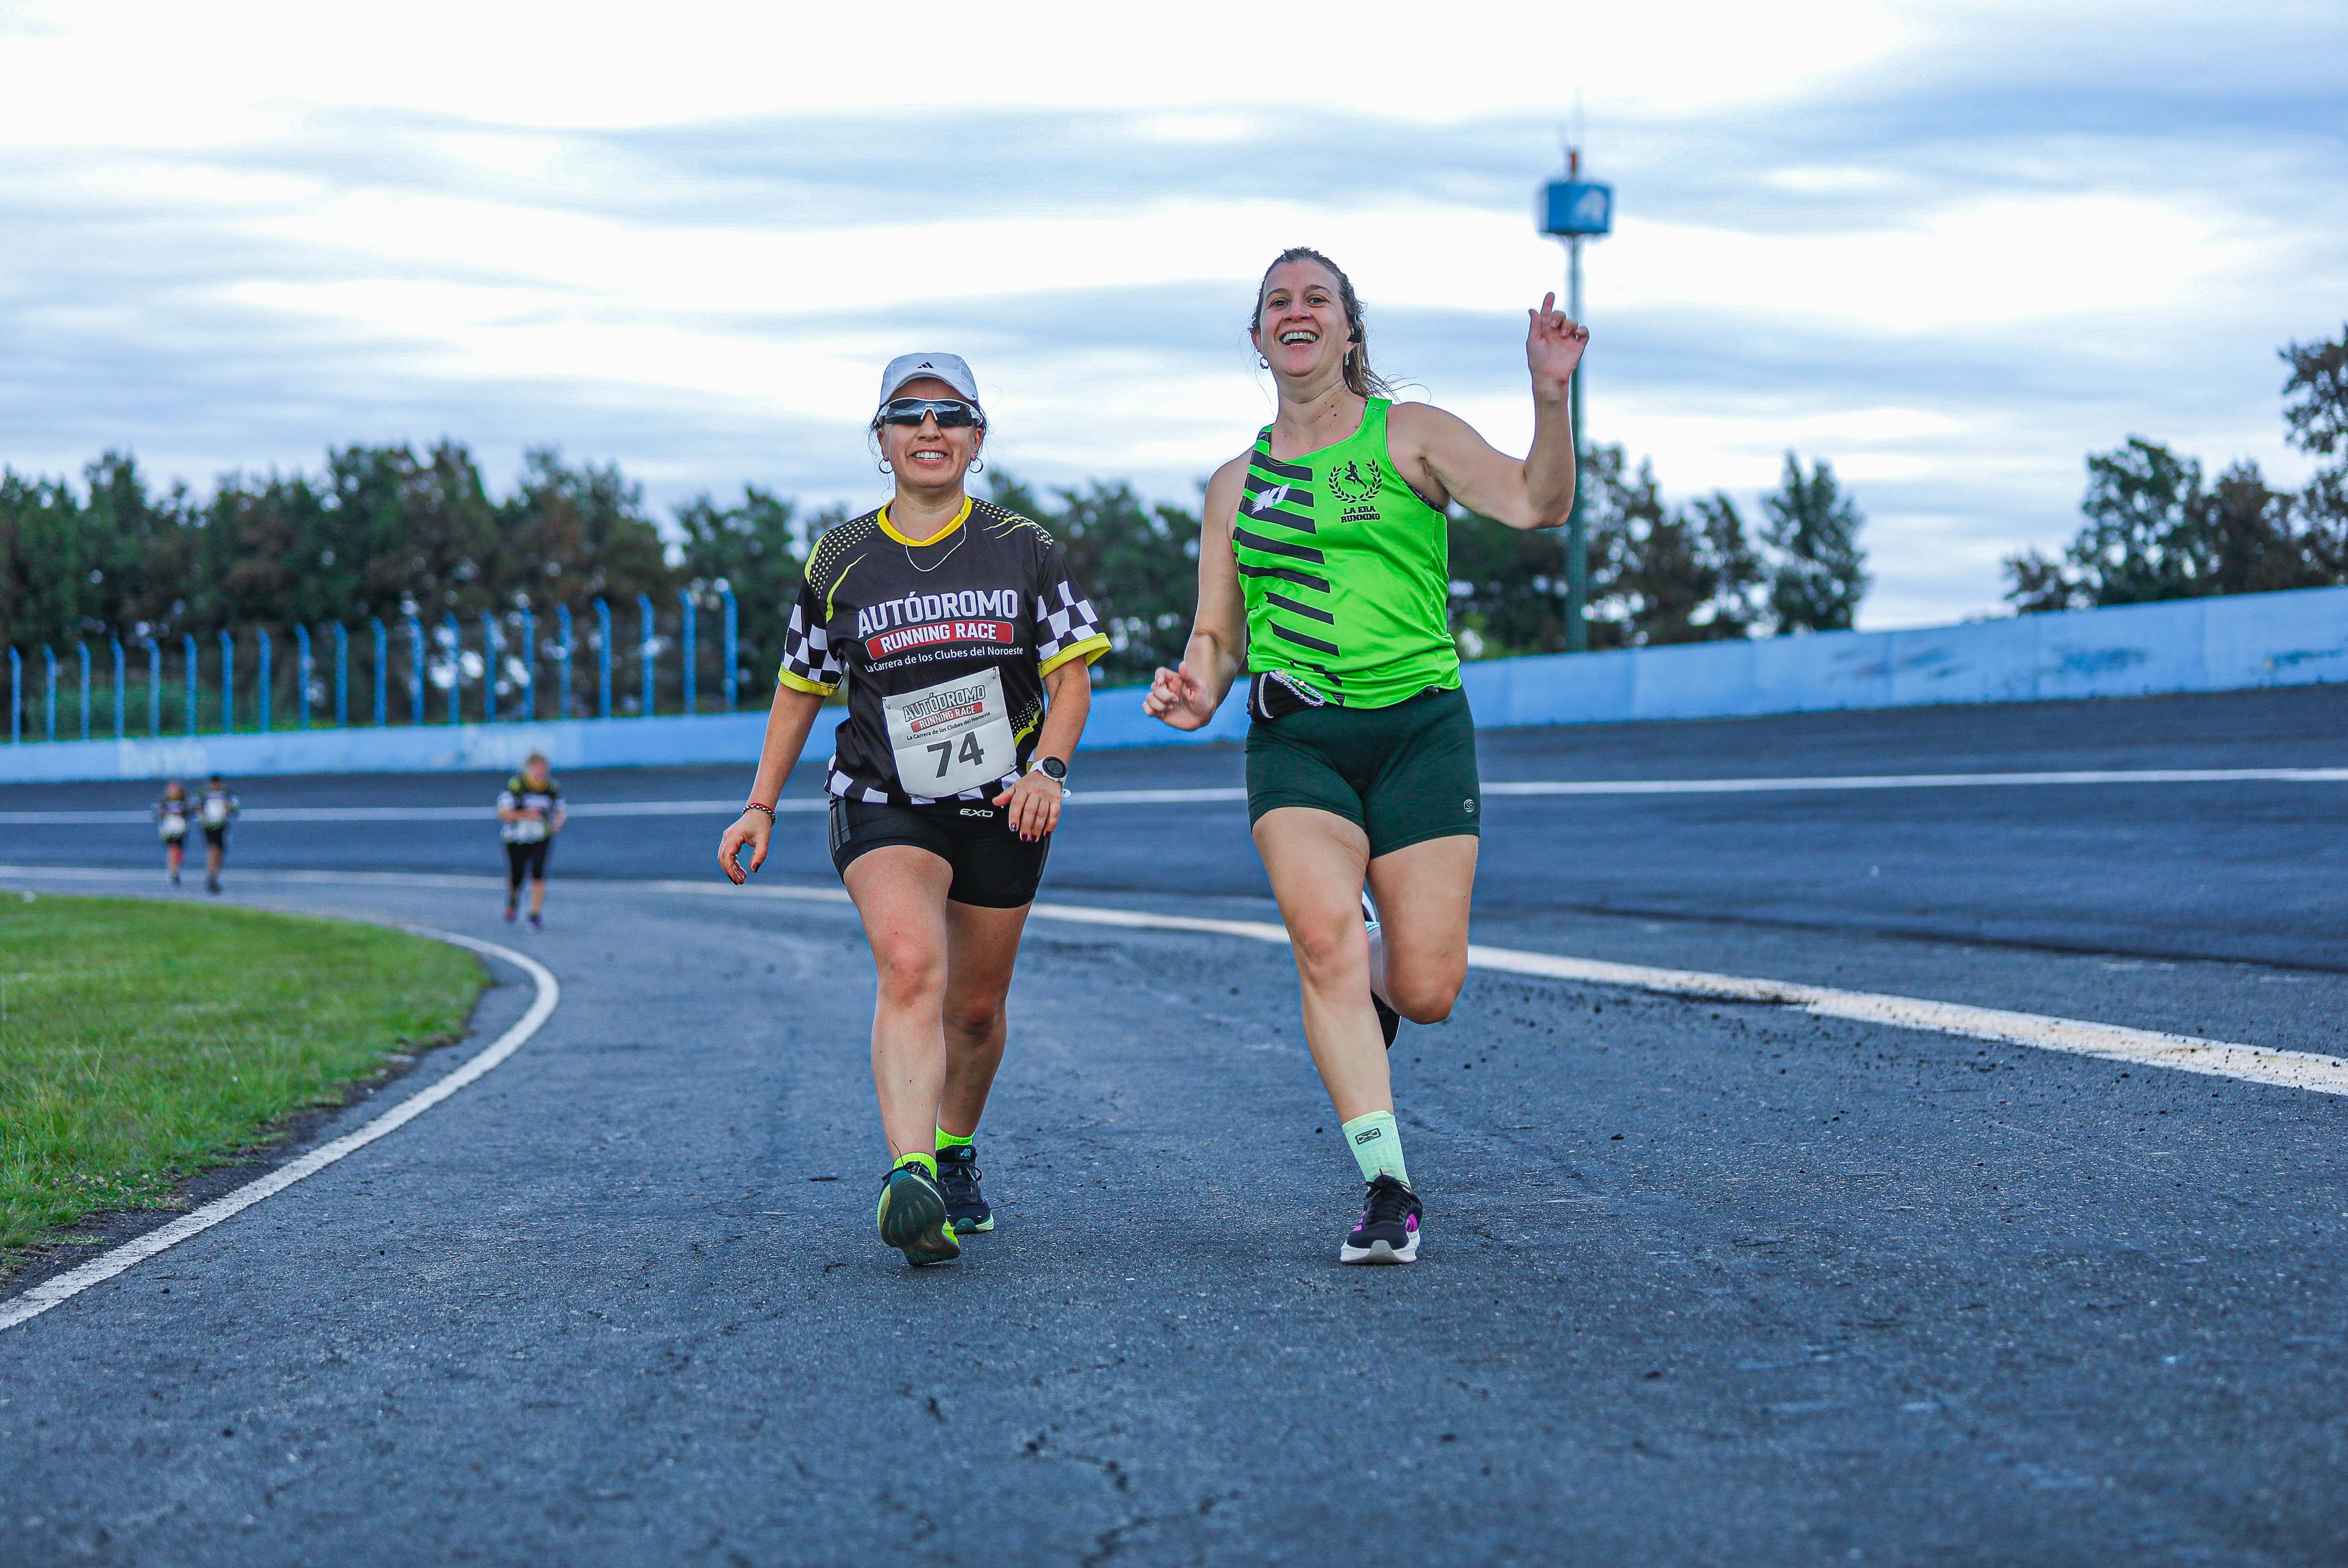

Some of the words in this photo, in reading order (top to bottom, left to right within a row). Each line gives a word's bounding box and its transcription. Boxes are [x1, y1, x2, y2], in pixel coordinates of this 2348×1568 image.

[1340, 513, 1381, 523] RUNNING
[857, 589, 1018, 639] AUTÓDROMO
[880, 624, 950, 654] RUNNING
[955, 622, 997, 640] RACE
[865, 664, 874, 673] La
[874, 660, 903, 671] Carrera
[905, 656, 917, 665] de
[919, 652, 933, 662] los
[935, 648, 968, 660] Clubes
[970, 646, 985, 656] del
[987, 646, 1023, 655] Noroeste
[903, 685, 986, 722] AUTÓDROMO
[919, 710, 953, 729] RUNNING
[955, 705, 976, 717] RACE
[971, 712, 990, 723] Noroeste
[927, 731, 985, 778] 74
[960, 808, 994, 817] EXO
